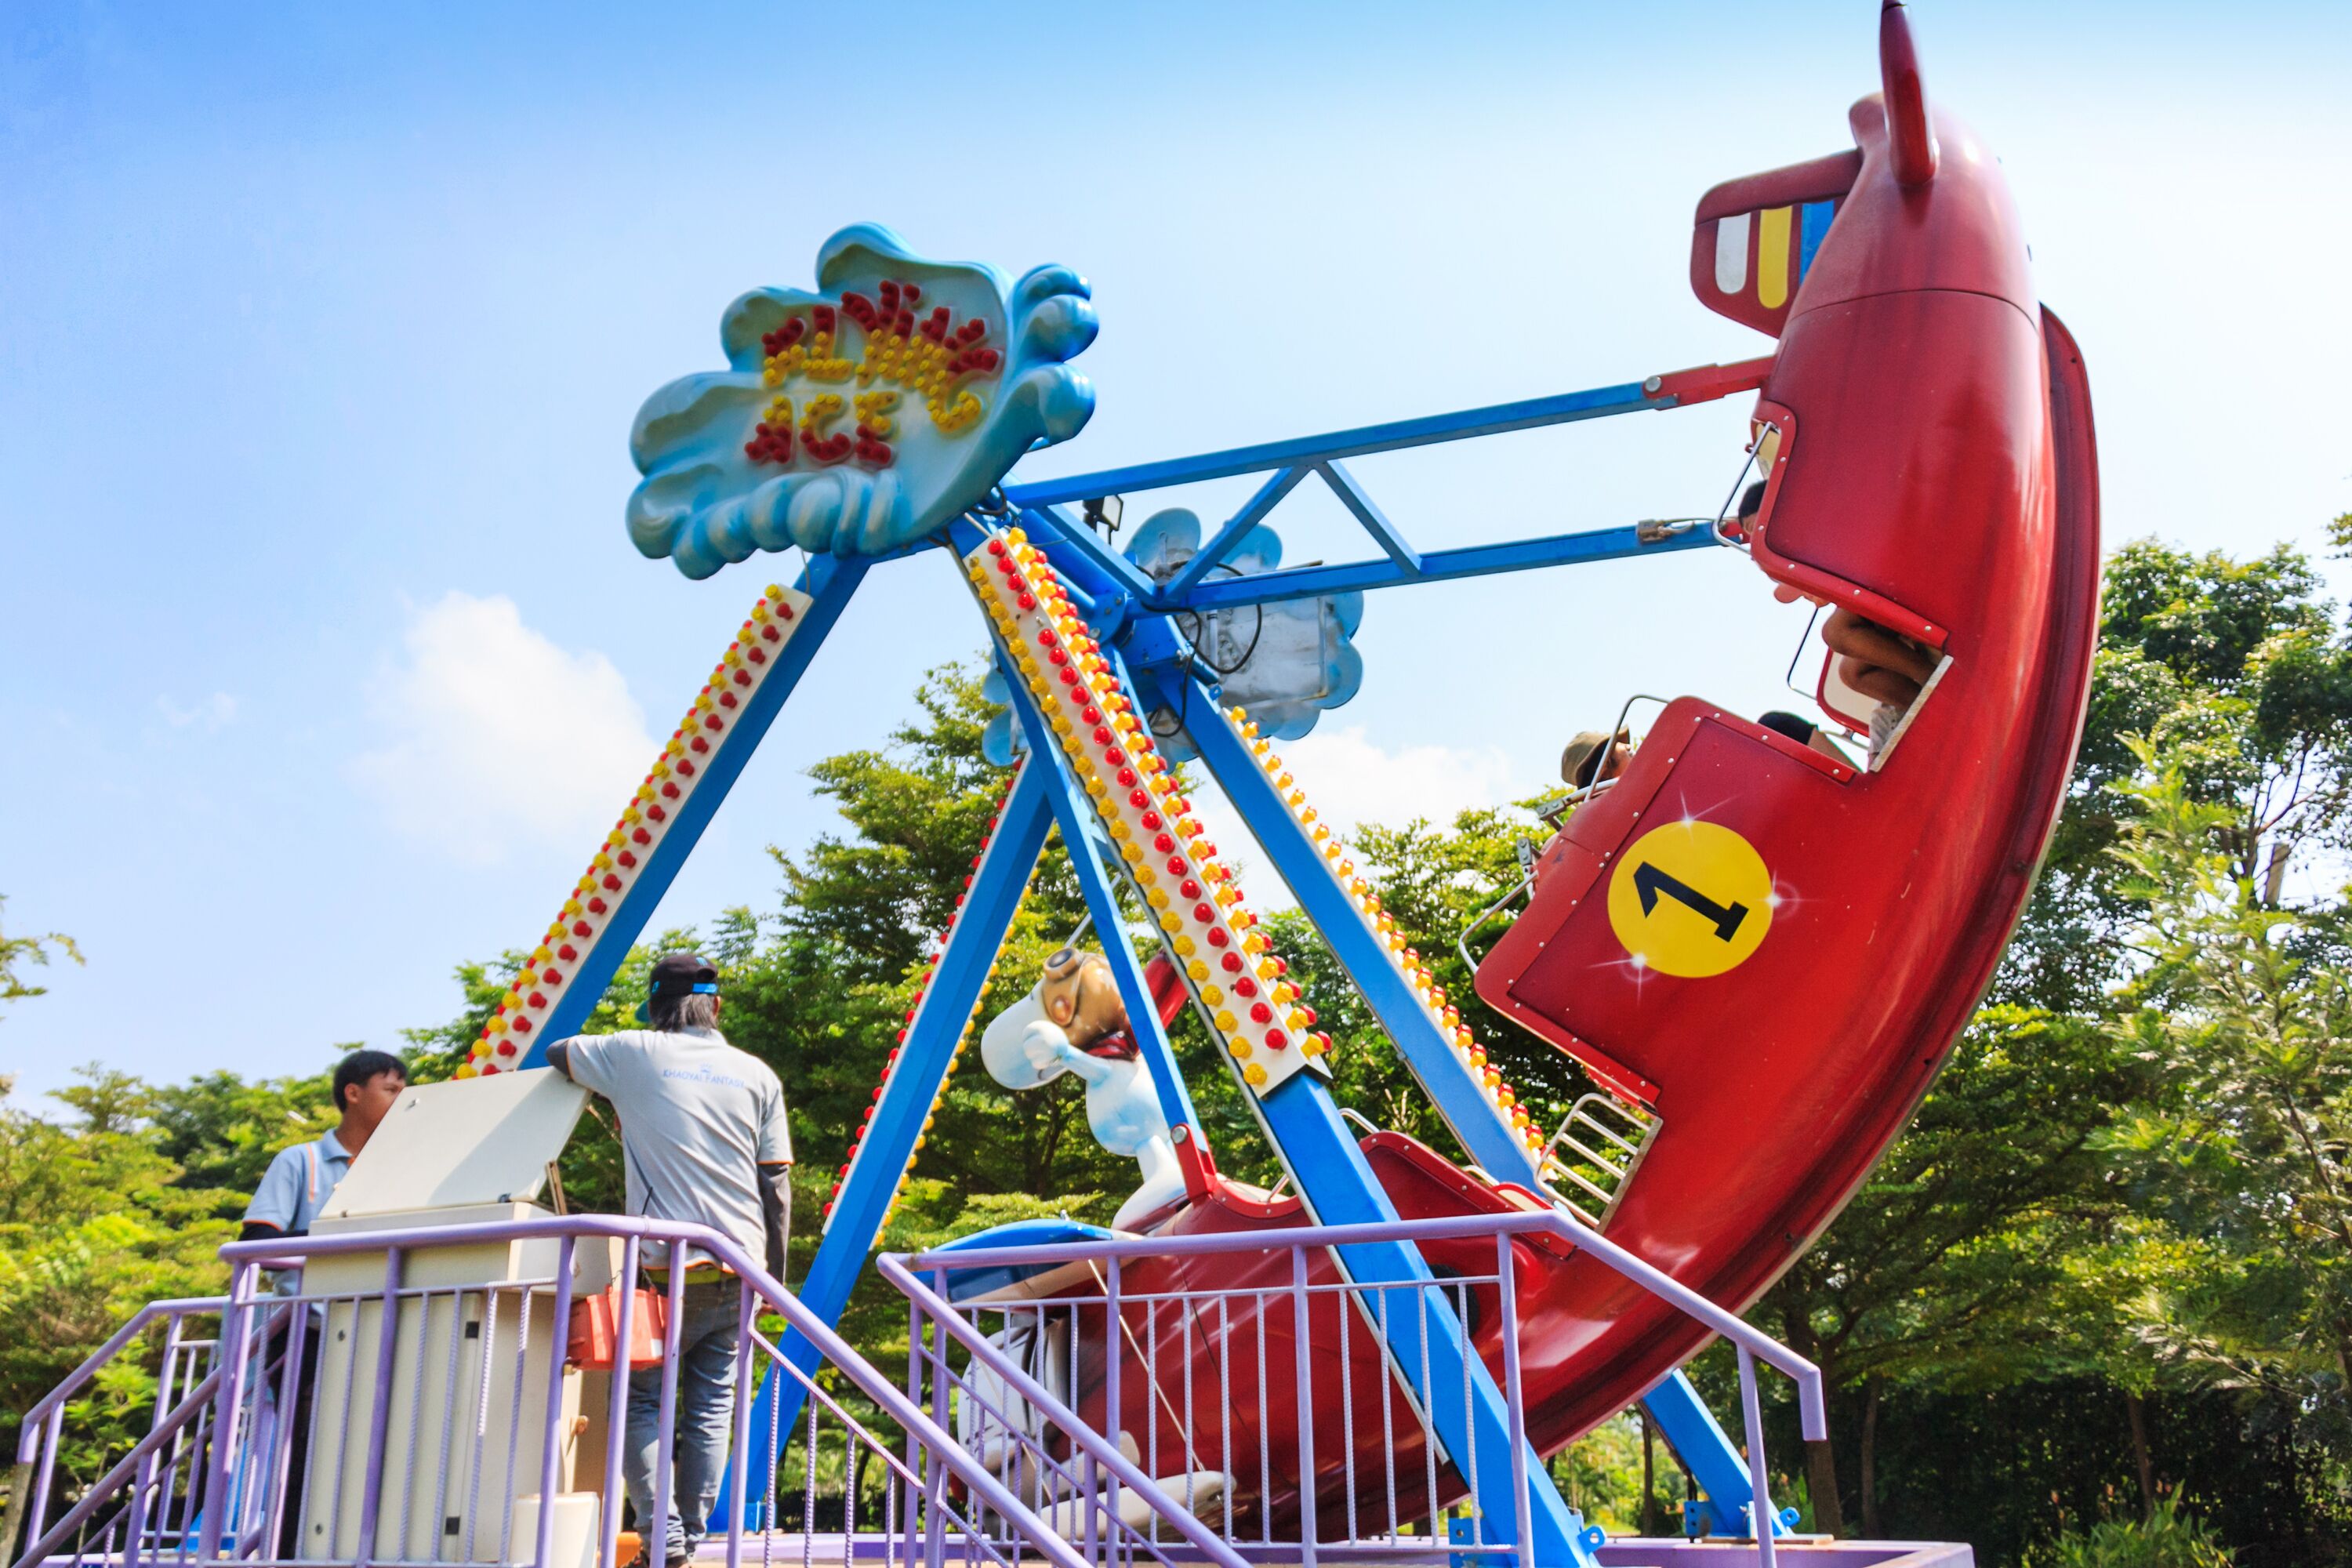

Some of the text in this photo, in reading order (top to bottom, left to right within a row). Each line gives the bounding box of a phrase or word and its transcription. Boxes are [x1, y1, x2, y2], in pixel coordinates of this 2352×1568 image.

[745, 392, 897, 463] ACE
[1633, 861, 1749, 942] 1
[706, 1075, 745, 1088] FANTASY
